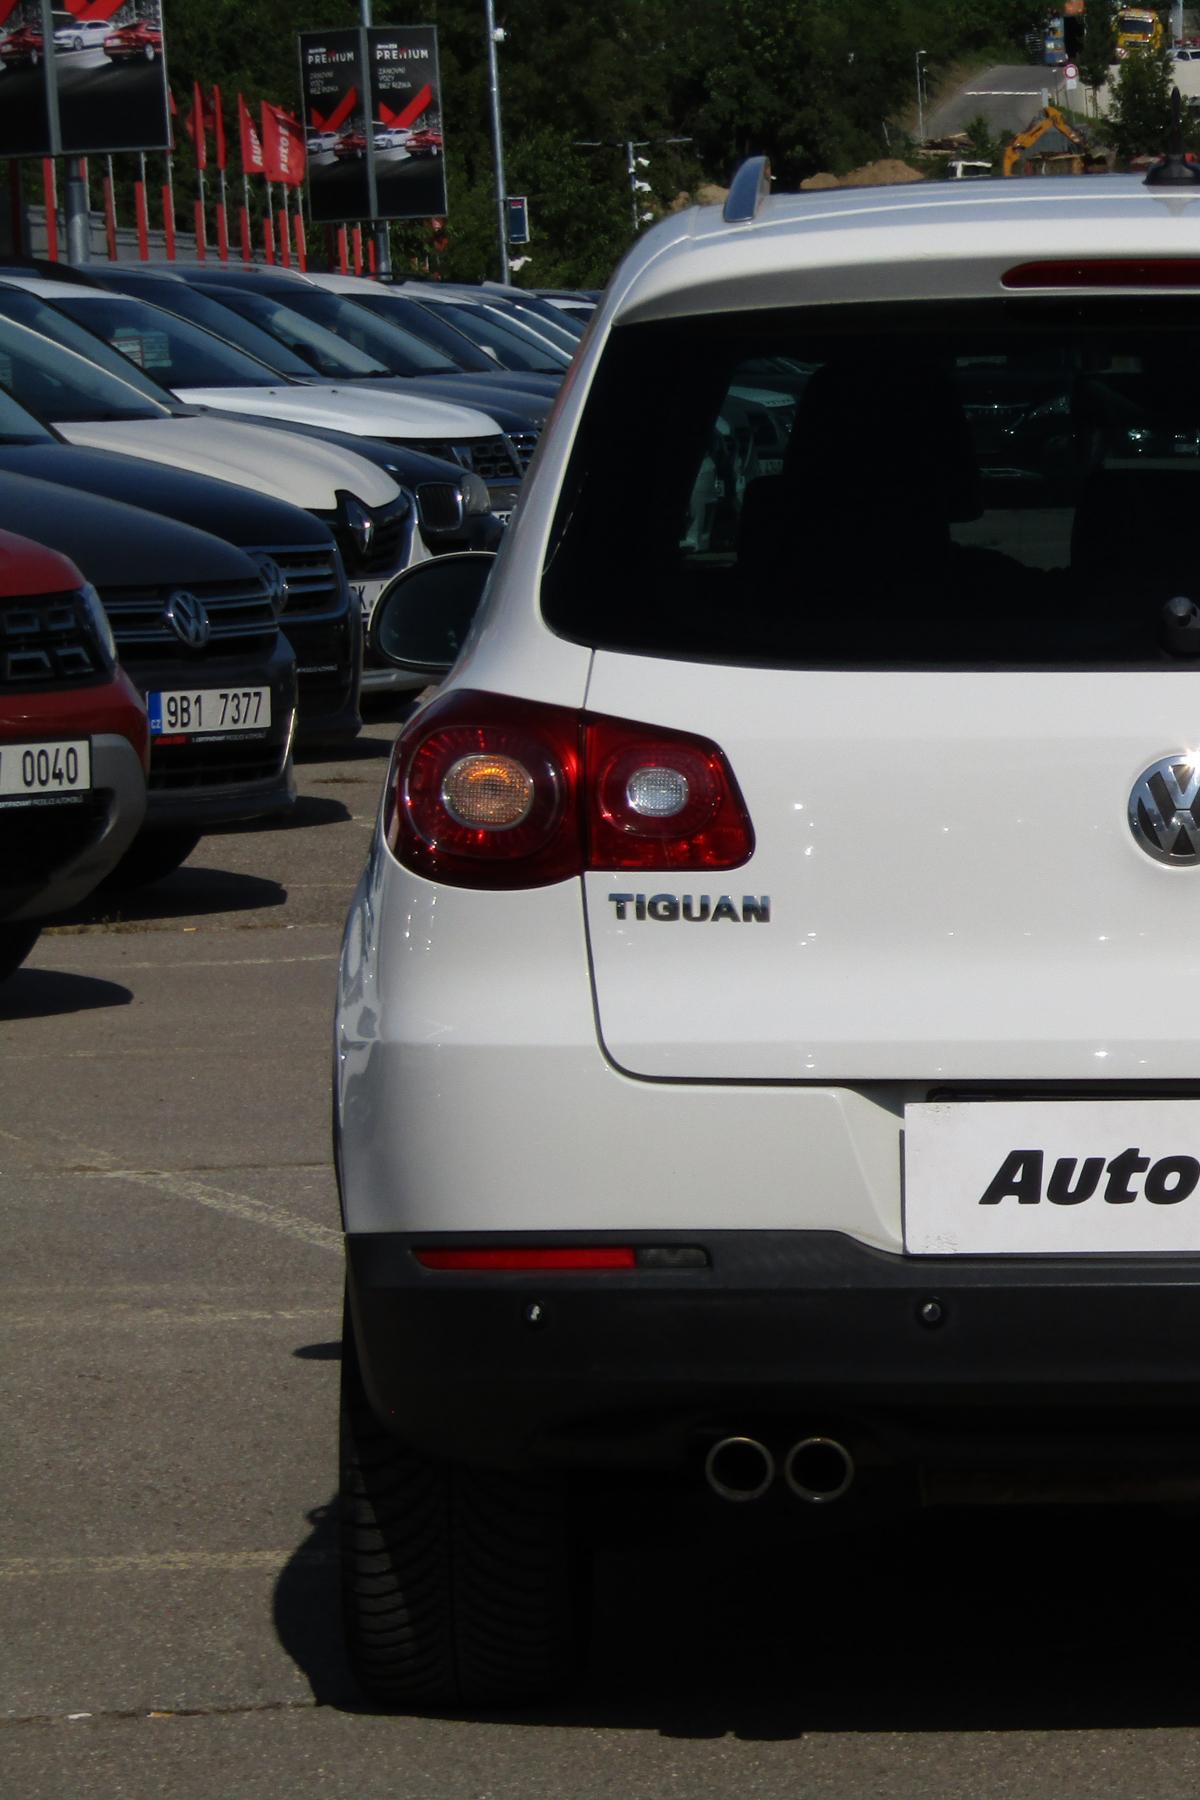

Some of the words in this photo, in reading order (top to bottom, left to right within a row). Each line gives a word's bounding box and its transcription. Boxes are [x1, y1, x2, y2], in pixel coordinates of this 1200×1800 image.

[151, 719, 162, 729] CZ
[167, 695, 202, 728] 9B1
[219, 691, 263, 727] 7377
[22, 746, 78, 788] 0040
[608, 893, 771, 923] TIGUAN
